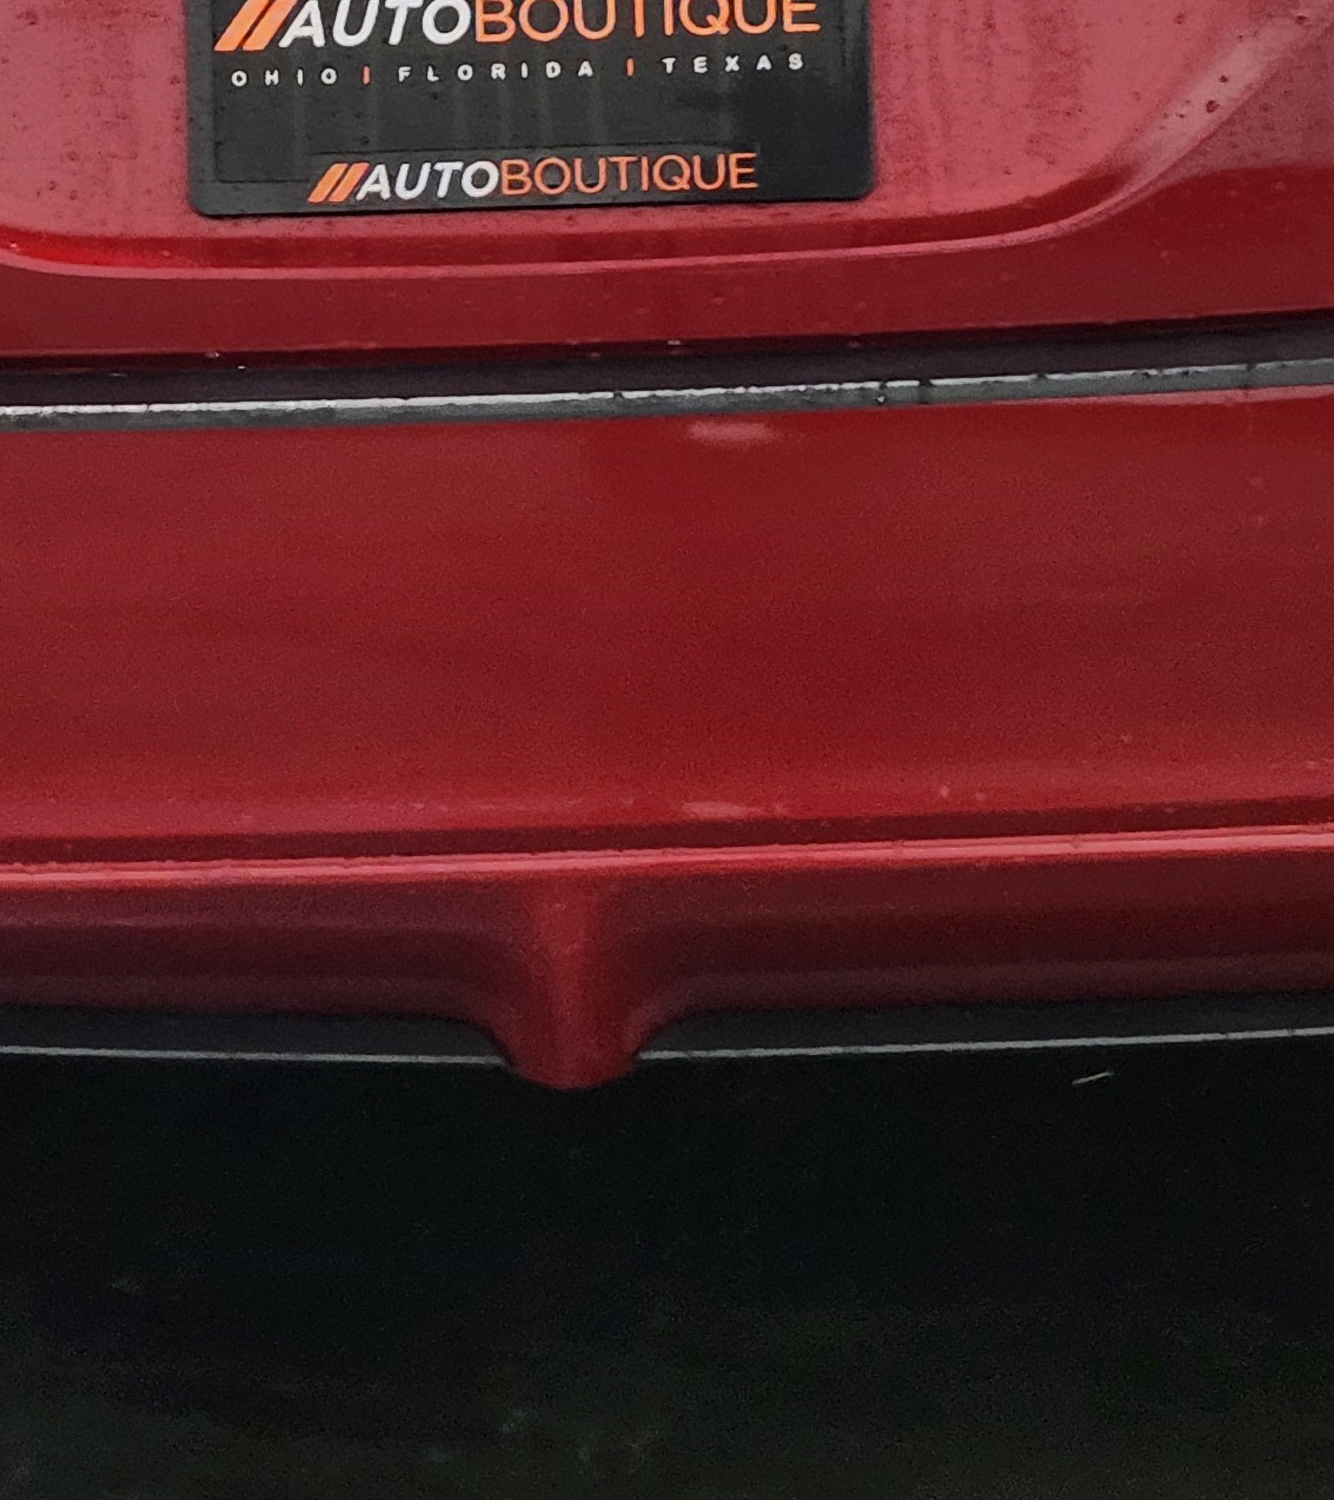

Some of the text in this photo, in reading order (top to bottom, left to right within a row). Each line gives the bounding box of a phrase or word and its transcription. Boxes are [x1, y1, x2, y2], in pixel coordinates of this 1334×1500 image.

[230, 52, 804, 87] OHIO FLORIDA TEXAS
